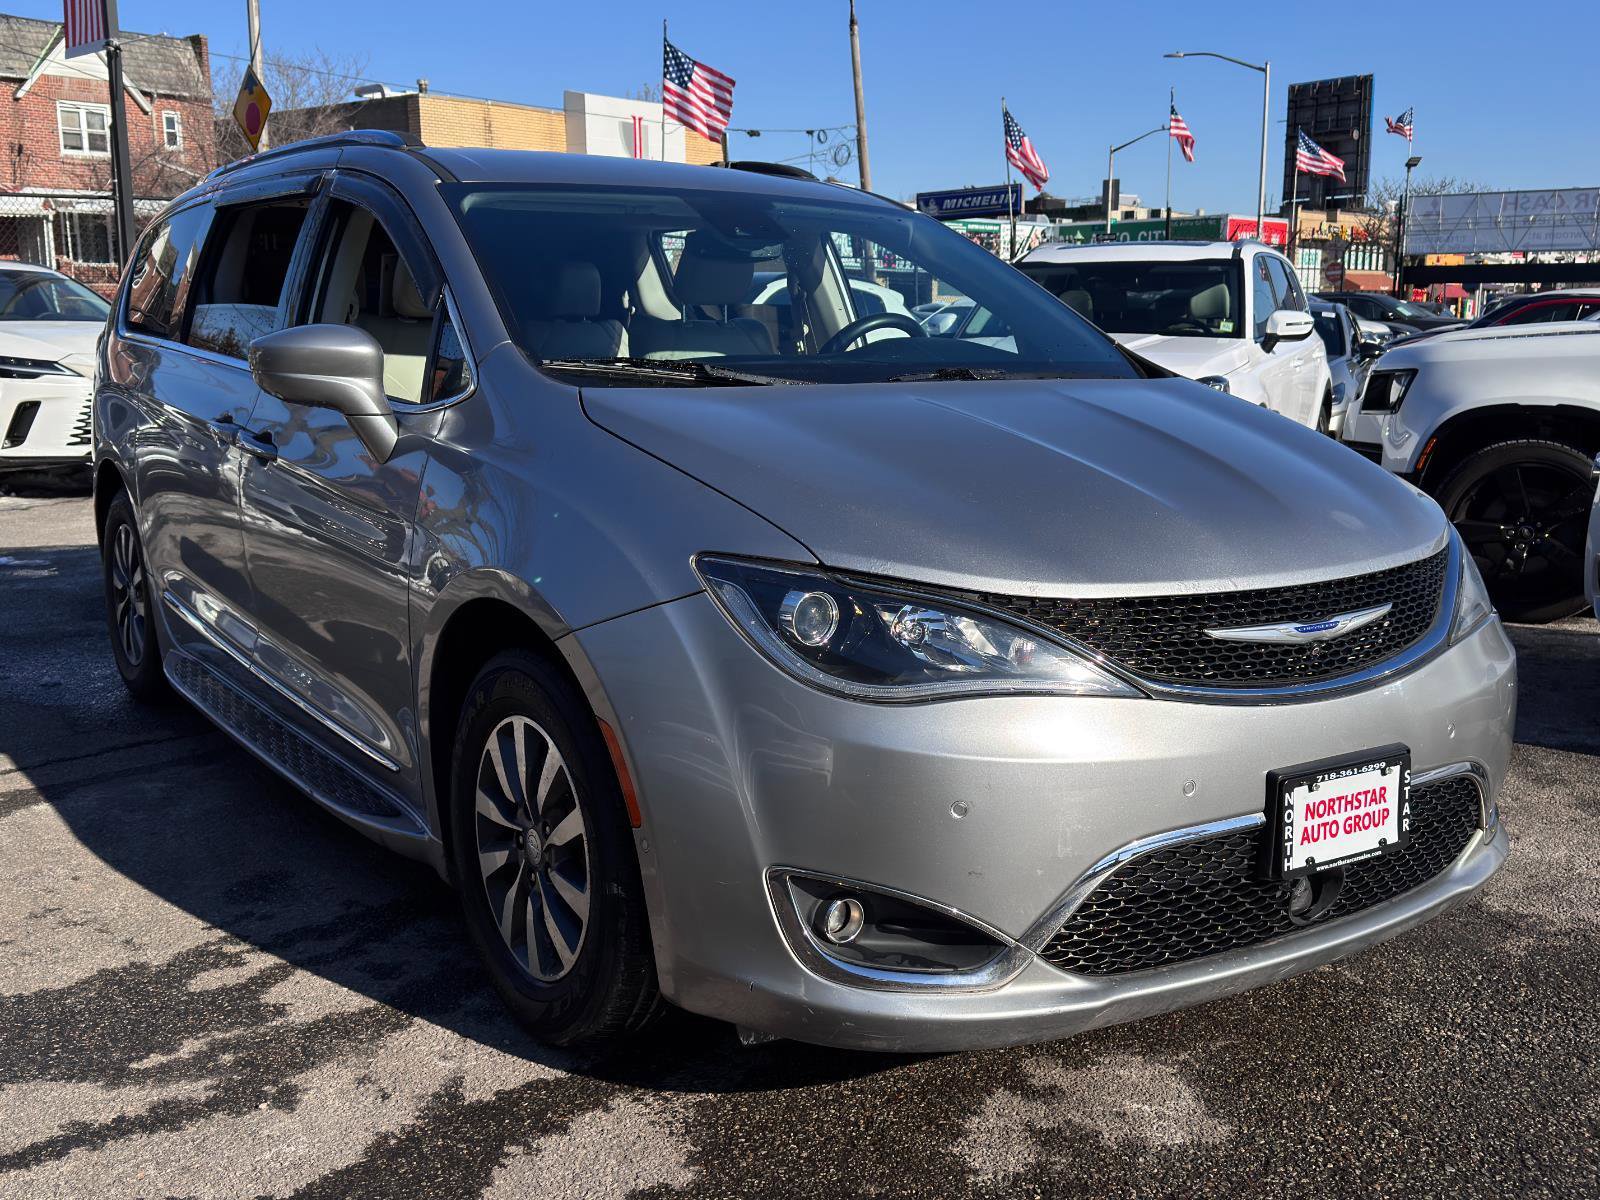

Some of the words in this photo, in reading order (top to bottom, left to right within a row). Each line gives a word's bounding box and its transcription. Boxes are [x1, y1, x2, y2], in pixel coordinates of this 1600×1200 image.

[942, 193, 1017, 209] MICHELIN
[1137, 230, 1166, 241] CIT
[1316, 761, 1386, 782] 718-361-6299
[1304, 786, 1387, 821] NORTHSTAR
[1402, 769, 1411, 832] STAR
[1284, 792, 1294, 871] NORTH
[1300, 819, 1339, 846] AUTO
[1343, 807, 1390, 835] GROUP
